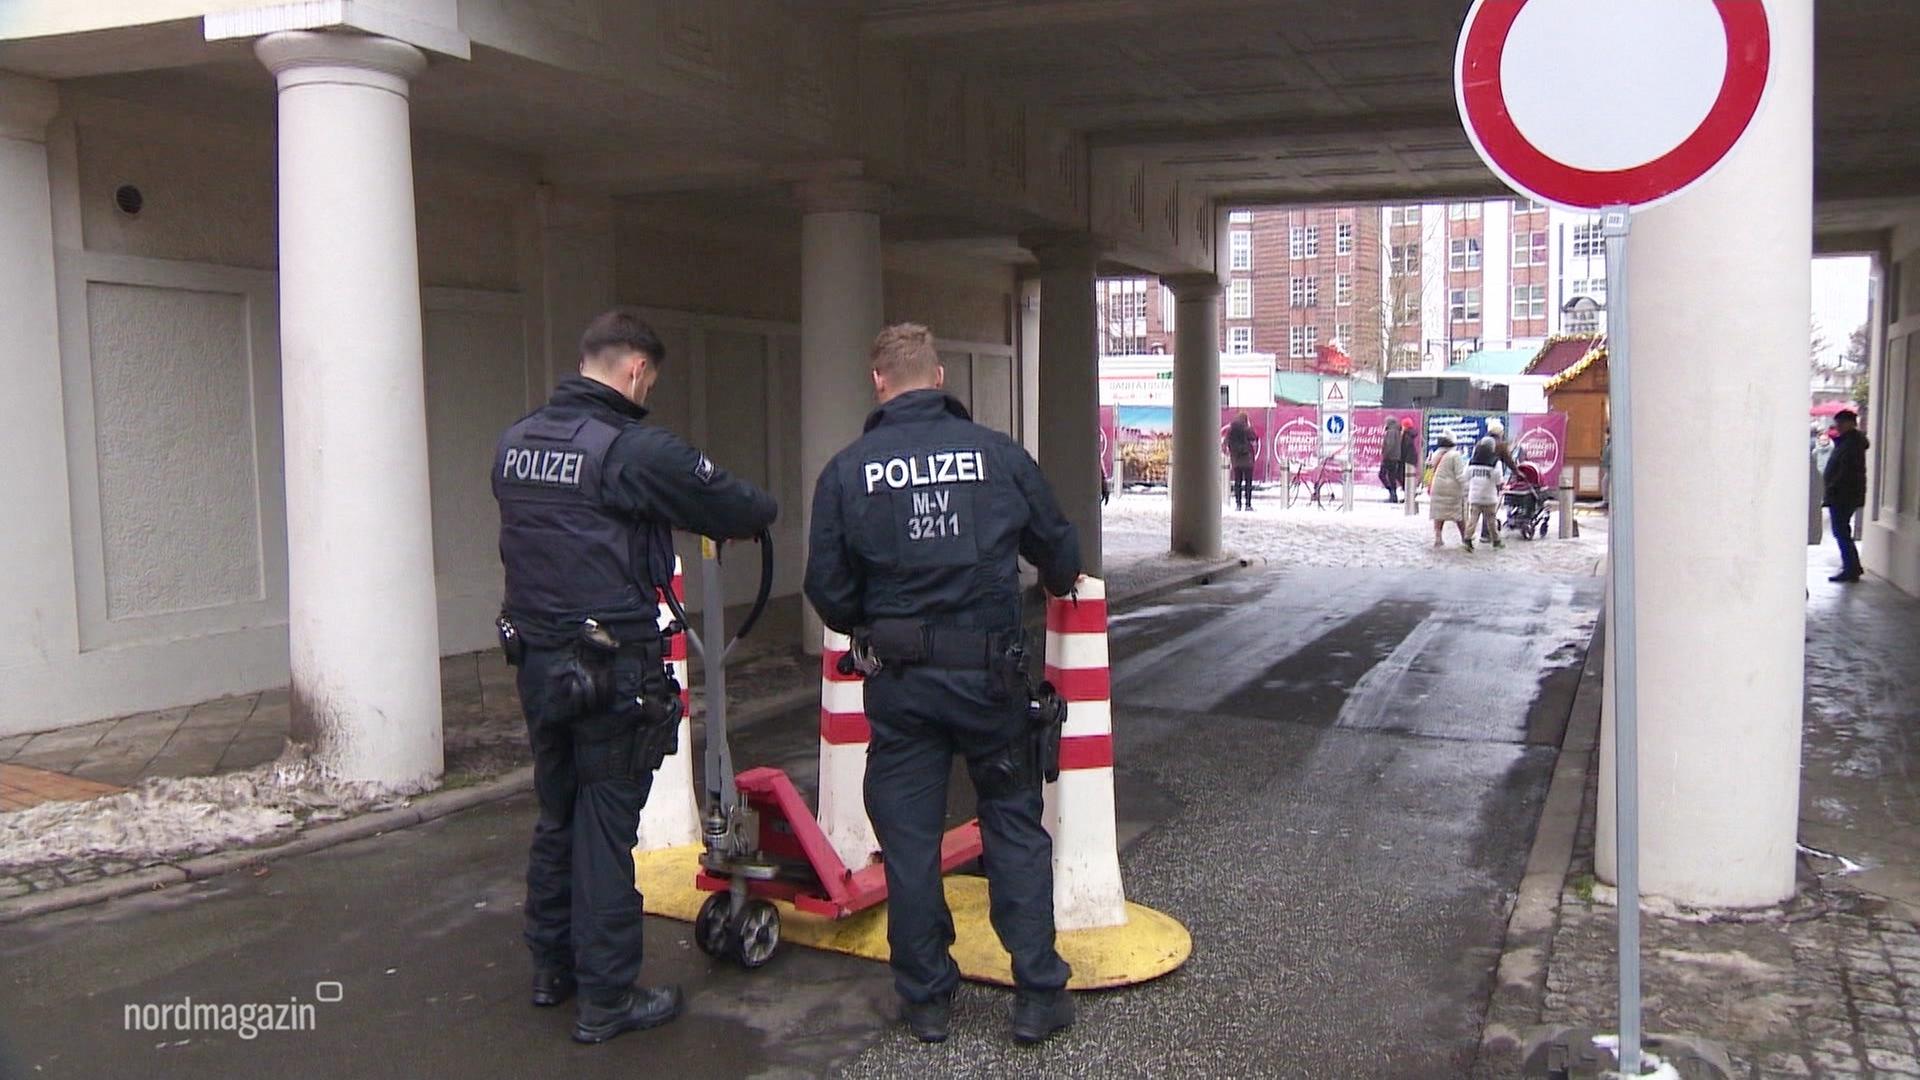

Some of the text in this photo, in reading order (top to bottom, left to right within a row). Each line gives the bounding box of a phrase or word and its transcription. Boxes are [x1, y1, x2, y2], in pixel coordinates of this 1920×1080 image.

[503, 448, 584, 484] POLIZEI
[864, 451, 985, 494] POLIZEI
[912, 490, 950, 515] M-V
[908, 512, 960, 540] 3211
